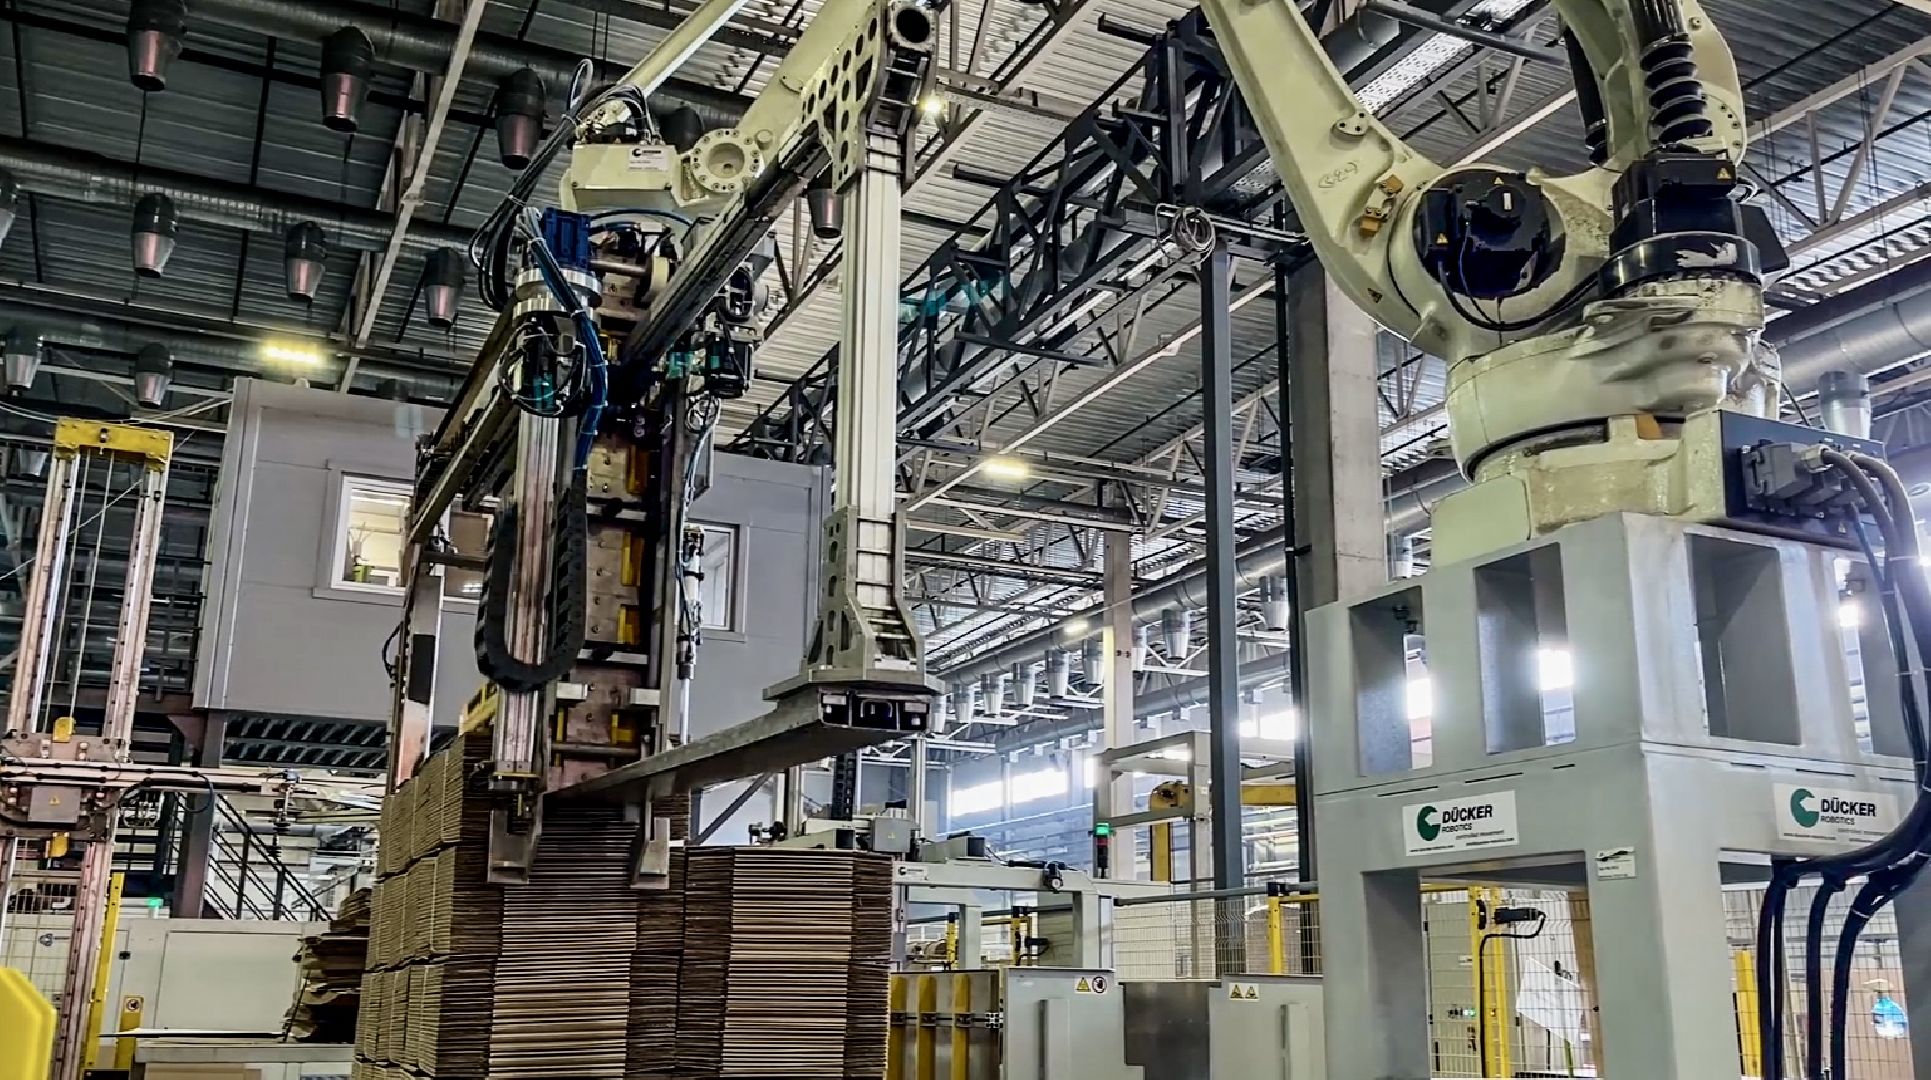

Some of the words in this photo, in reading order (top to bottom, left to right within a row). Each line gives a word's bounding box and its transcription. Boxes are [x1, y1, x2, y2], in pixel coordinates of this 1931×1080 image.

[1442, 804, 1493, 823] DÜCKER
[1821, 797, 1876, 817] DÜCKER
[1442, 823, 1472, 833] ROBOTICS
